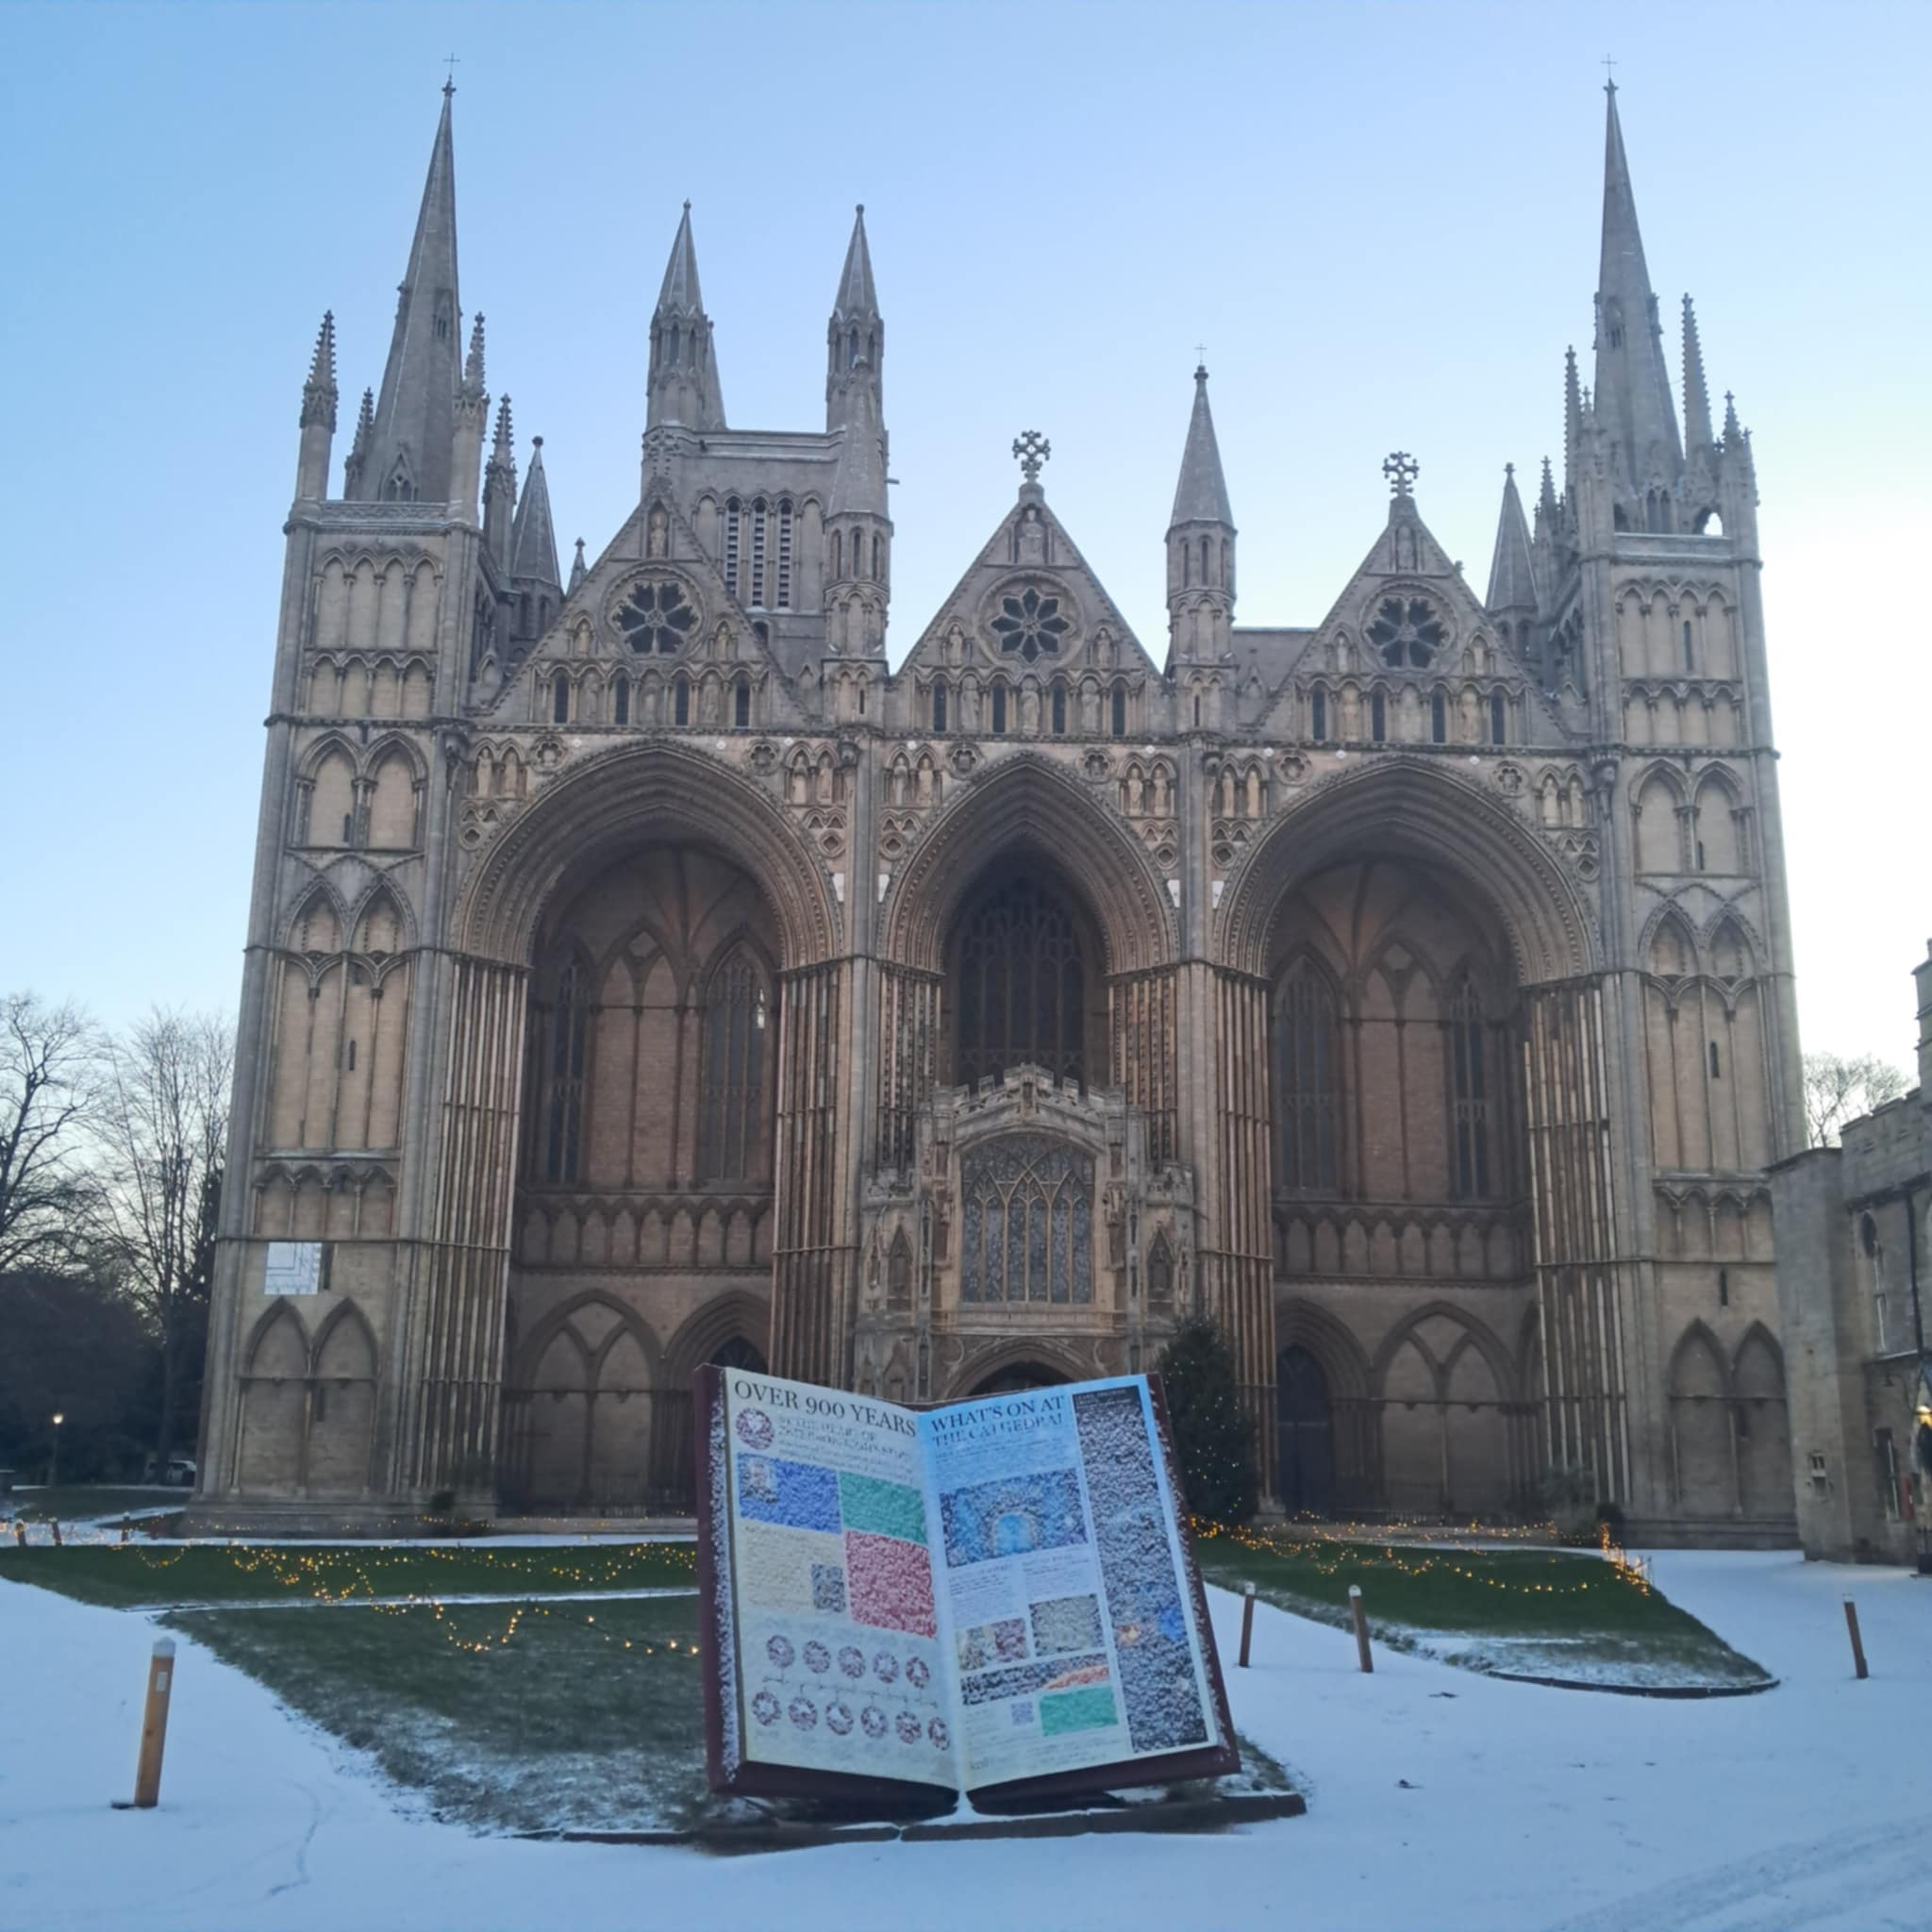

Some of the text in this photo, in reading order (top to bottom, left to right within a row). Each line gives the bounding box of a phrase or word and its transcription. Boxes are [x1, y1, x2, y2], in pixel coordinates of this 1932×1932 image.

[734, 1380, 799, 1409] OVER
[806, 1396, 845, 1419] 900
[851, 1404, 916, 1437] YEARS
[931, 1405, 1003, 1432] WHAT'S
[1007, 1400, 1035, 1416] ON
[1041, 1395, 1065, 1412] AT
